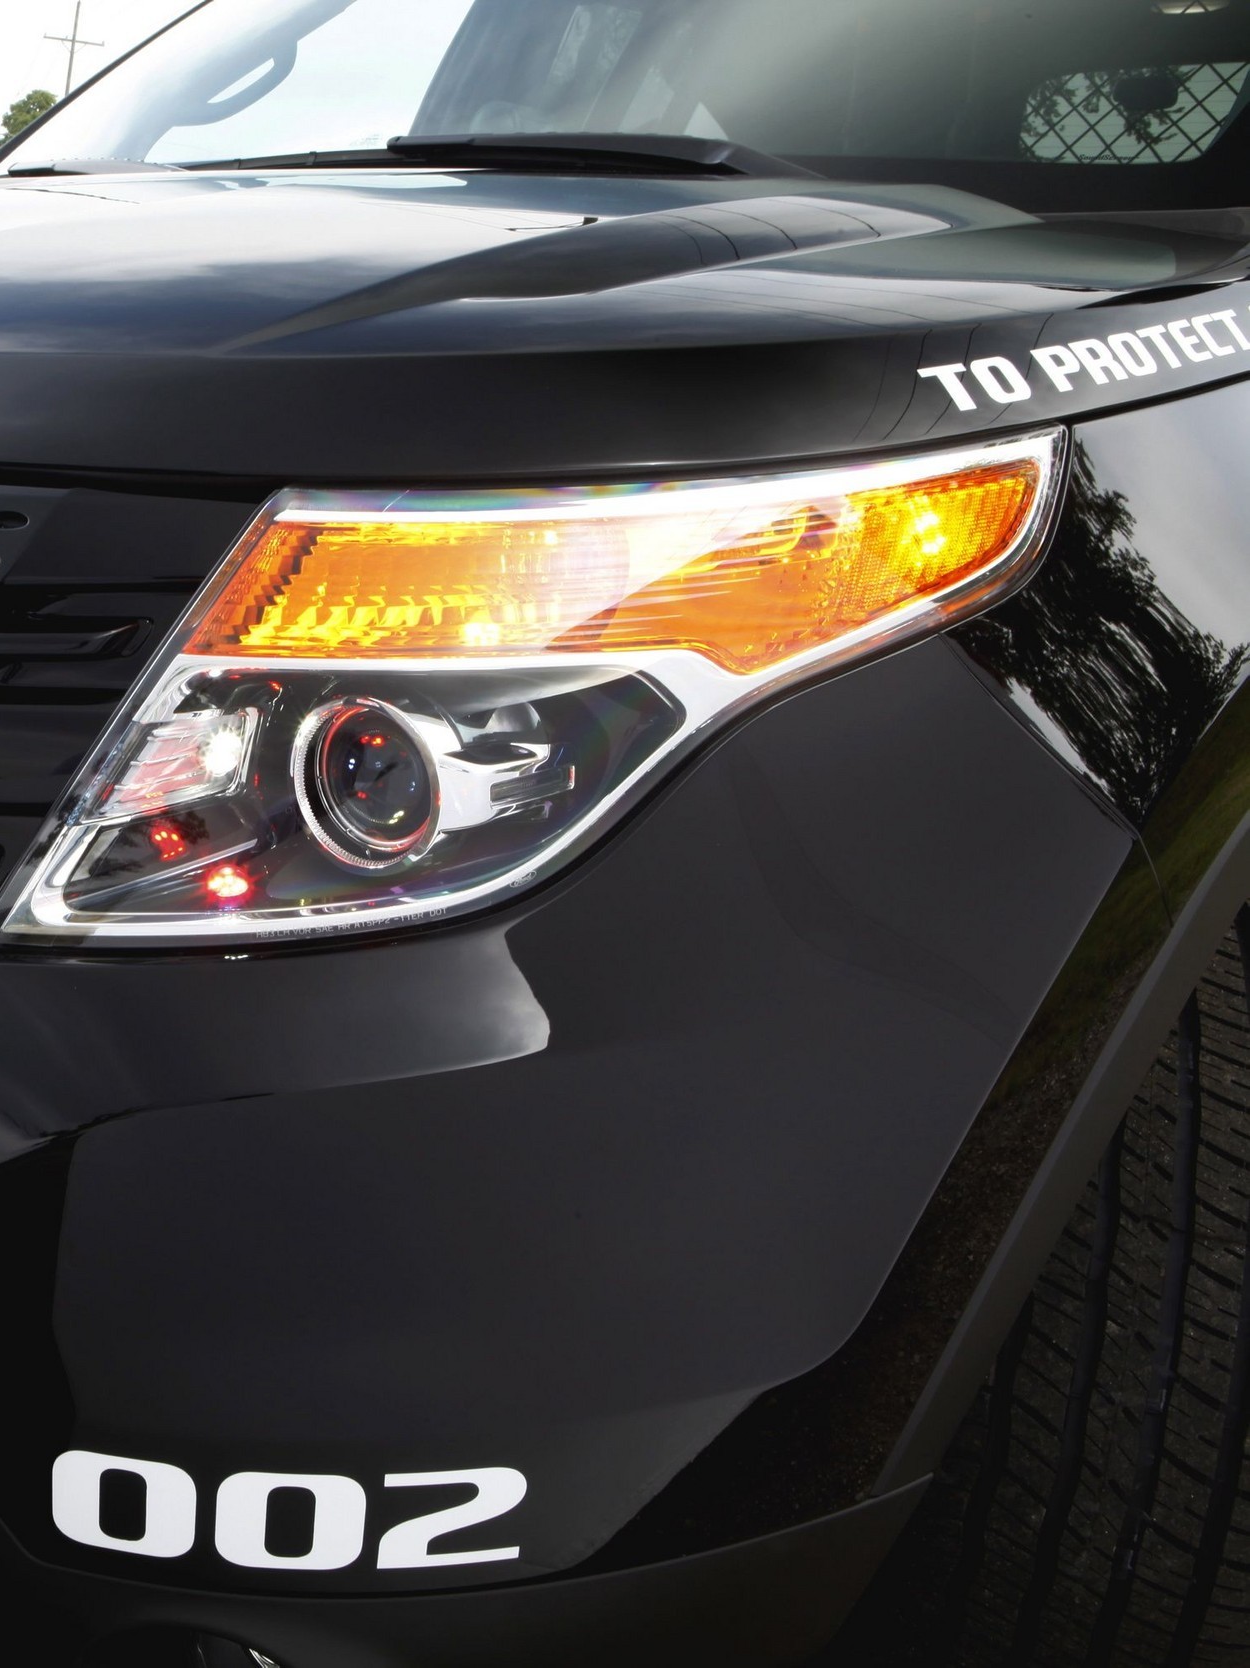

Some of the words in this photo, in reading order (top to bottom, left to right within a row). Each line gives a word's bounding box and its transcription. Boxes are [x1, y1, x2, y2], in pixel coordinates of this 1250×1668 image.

[917, 355, 1032, 412] TO
[1029, 309, 1250, 393] PROTECT
[52, 1449, 528, 1571] 002
